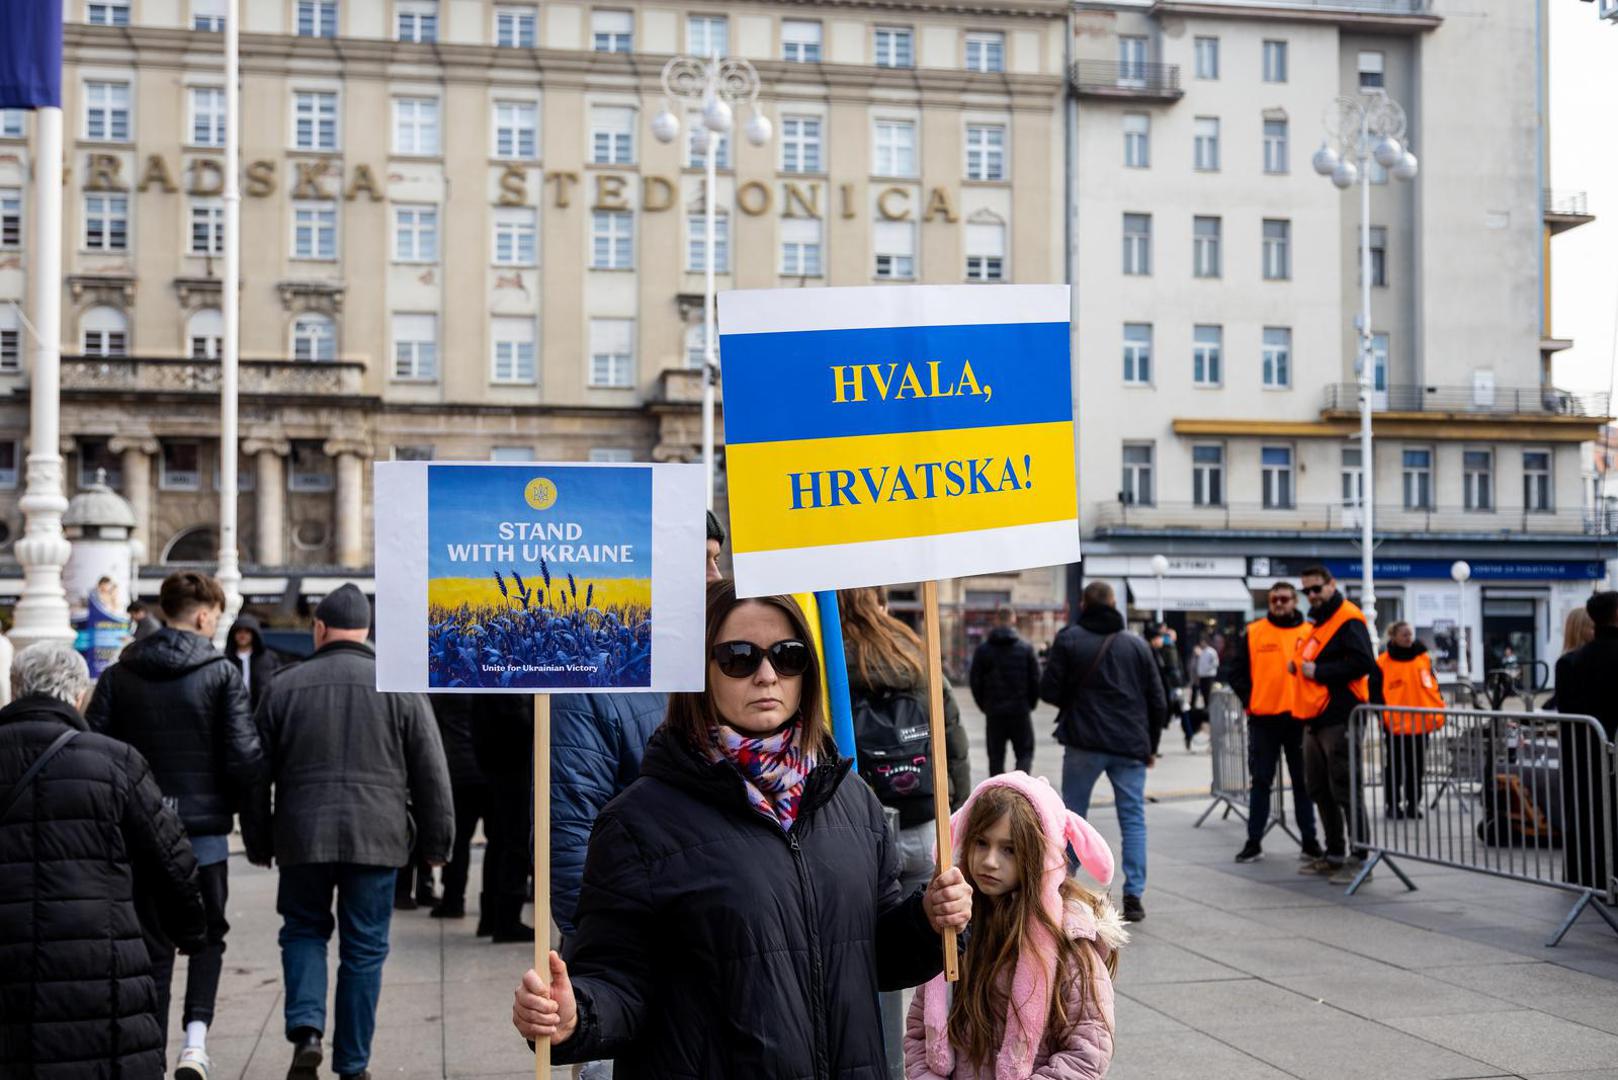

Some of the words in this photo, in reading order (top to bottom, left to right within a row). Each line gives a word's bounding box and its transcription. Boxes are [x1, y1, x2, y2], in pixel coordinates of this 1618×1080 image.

[31, 149, 384, 202] RADSKA
[830, 359, 993, 403] HVALA,
[787, 454, 1032, 510] HRVATSKA!
[499, 522, 583, 541] STAND
[447, 544, 515, 562] WITH
[522, 544, 634, 563] UKRAINE
[482, 664, 506, 672] Unite
[507, 664, 522, 672] for
[523, 664, 565, 672] Ukrainian
[566, 664, 599, 673] Victory
